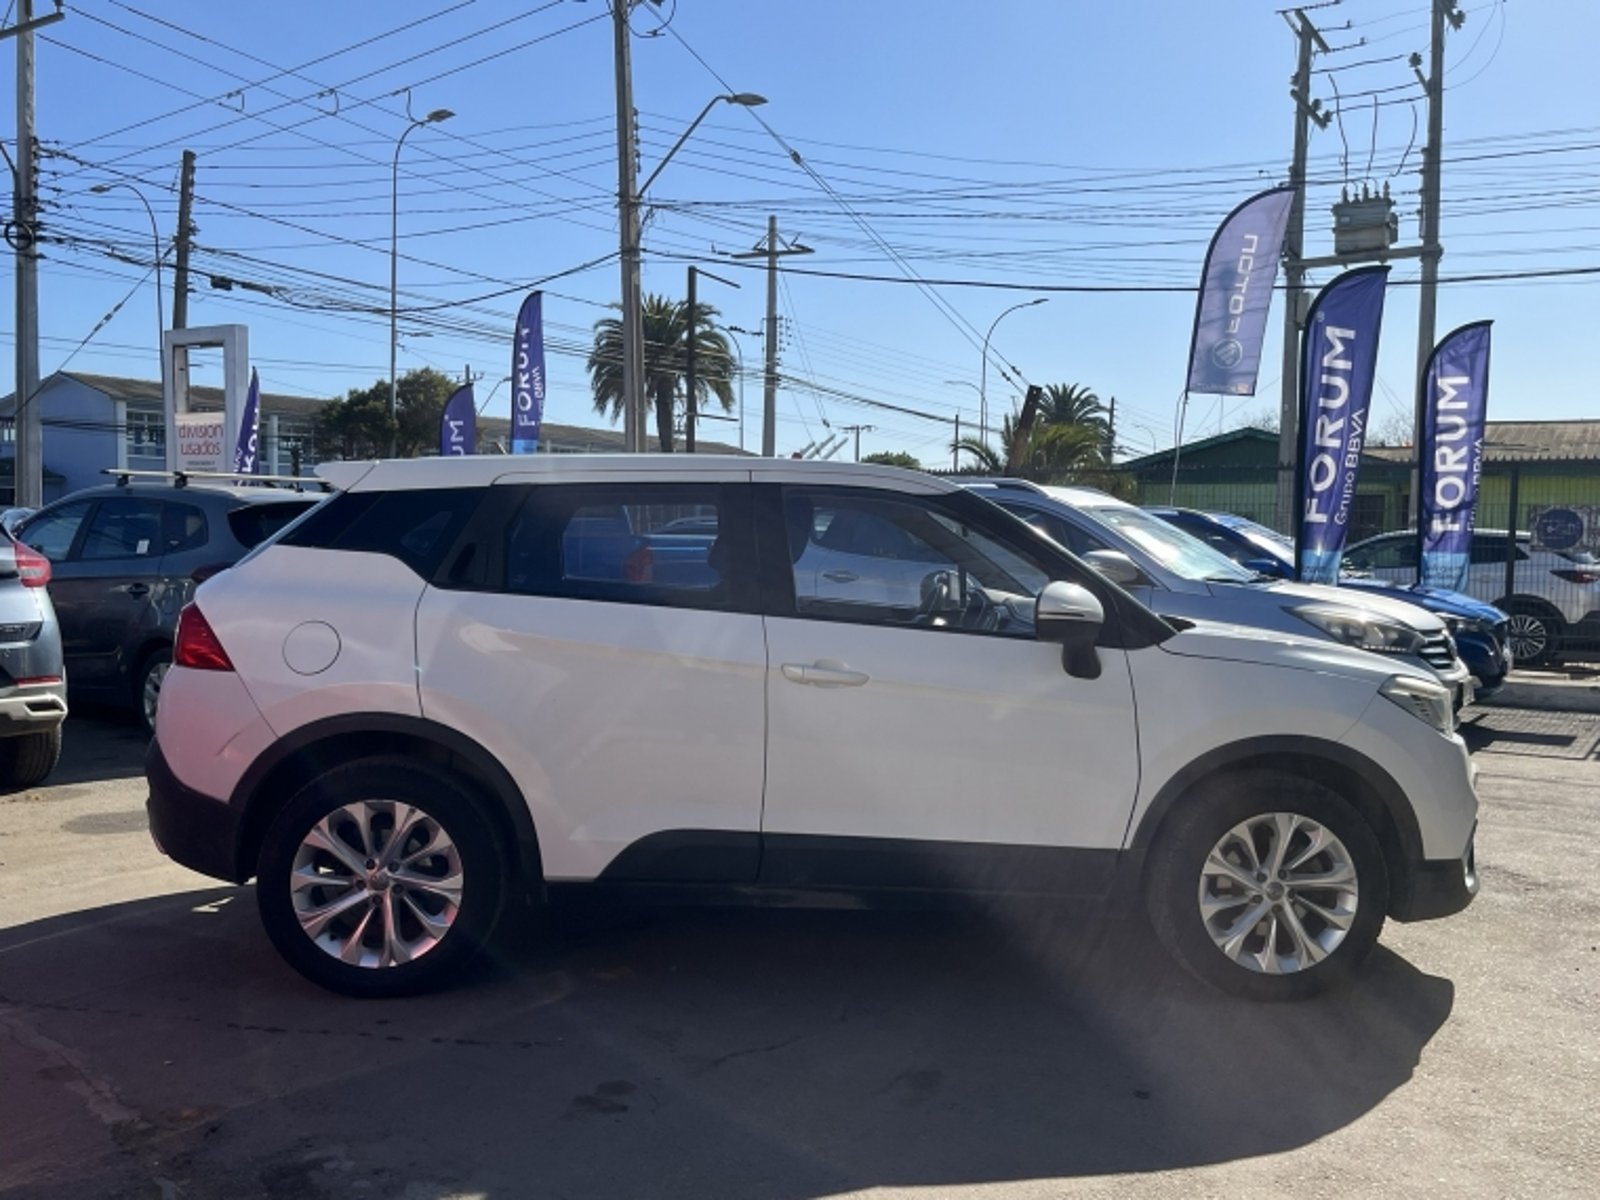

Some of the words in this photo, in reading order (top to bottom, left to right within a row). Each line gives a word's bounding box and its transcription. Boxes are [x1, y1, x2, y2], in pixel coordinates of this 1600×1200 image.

[181, 441, 221, 455] usados
[1304, 326, 1356, 524] FORUM
[1334, 471, 1355, 525] Grupo
[1345, 408, 1365, 468] BBVA
[1431, 376, 1470, 534] FORUM
